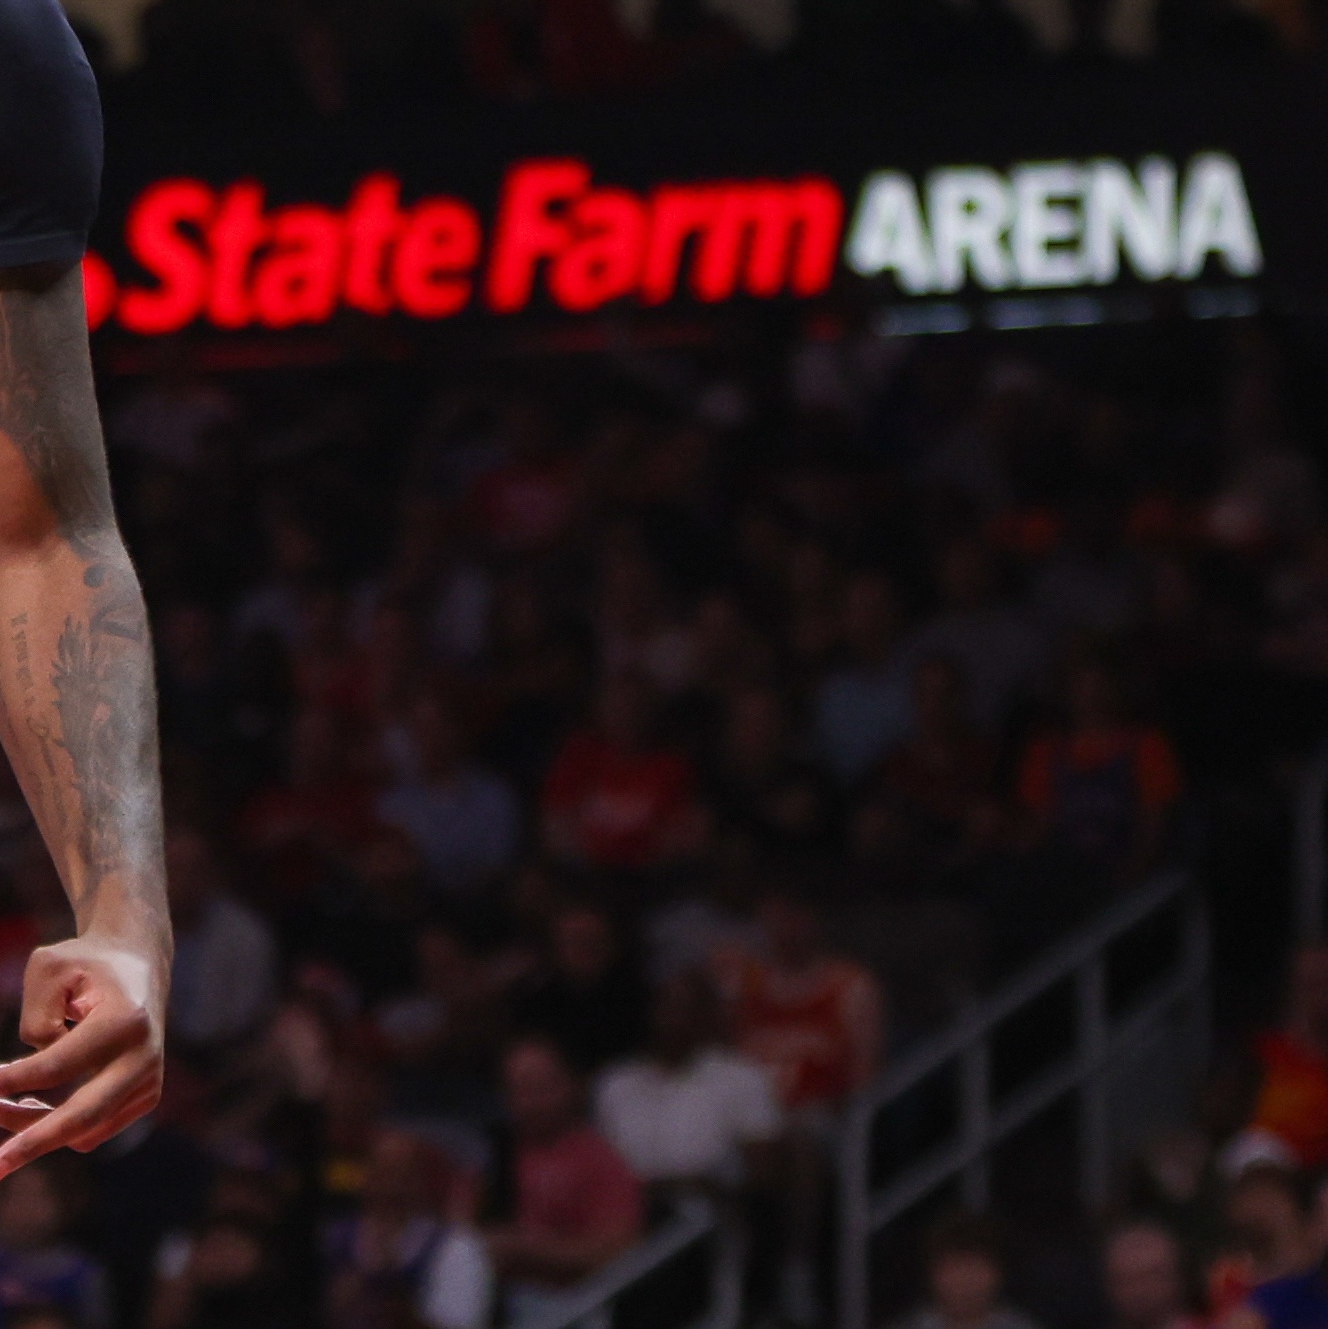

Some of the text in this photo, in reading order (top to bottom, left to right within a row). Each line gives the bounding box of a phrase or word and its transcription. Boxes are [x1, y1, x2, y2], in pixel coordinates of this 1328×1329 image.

[118, 150, 1264, 334] State Farm ARENA
